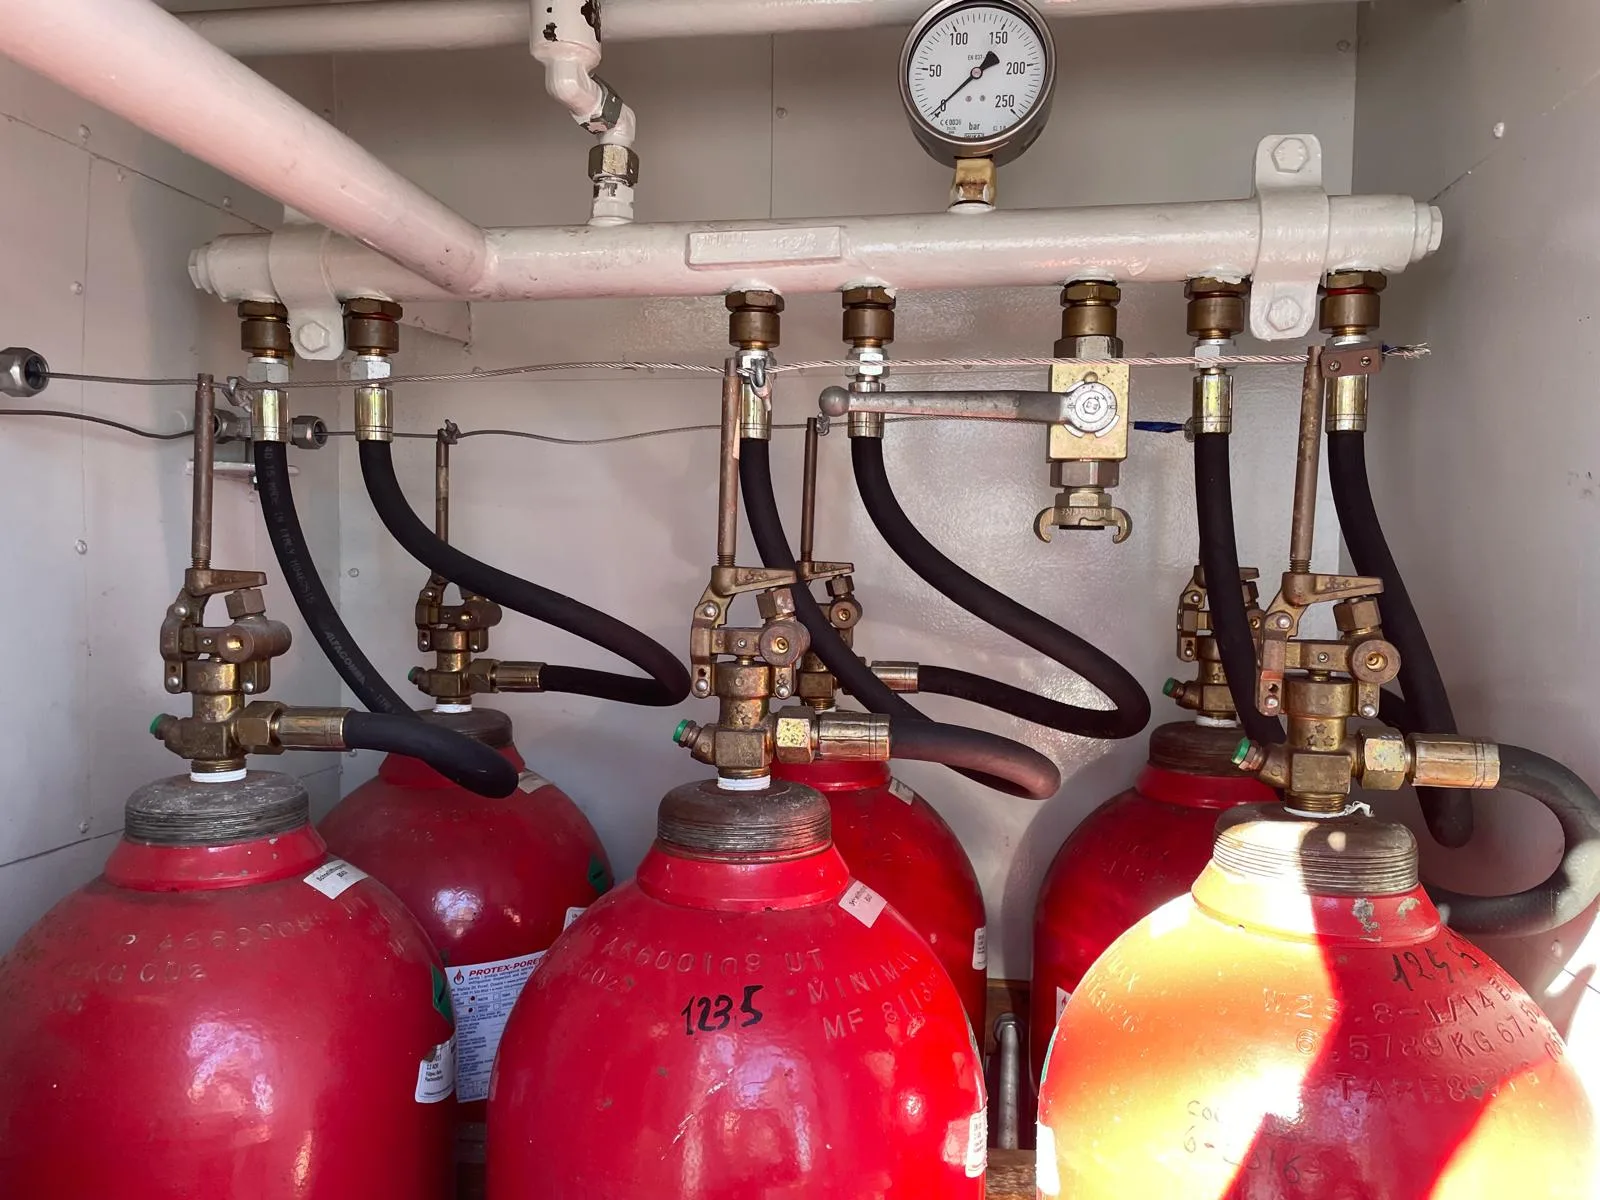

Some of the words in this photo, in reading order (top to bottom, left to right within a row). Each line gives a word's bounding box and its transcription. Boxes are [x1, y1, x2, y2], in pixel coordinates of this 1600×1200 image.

[949, 32, 969, 46] 100
[988, 31, 1009, 45] 150
[929, 64, 942, 77] 50
[1006, 61, 1026, 75] 200
[940, 99, 947, 112] 0
[995, 94, 1015, 108] 250
[968, 121, 980, 131] bar
[324, 630, 367, 686] ALFAGOMMA
[786, 947, 825, 974] UT
[822, 1007, 865, 1041] MF
[1448, 1030, 1497, 1060] KG
